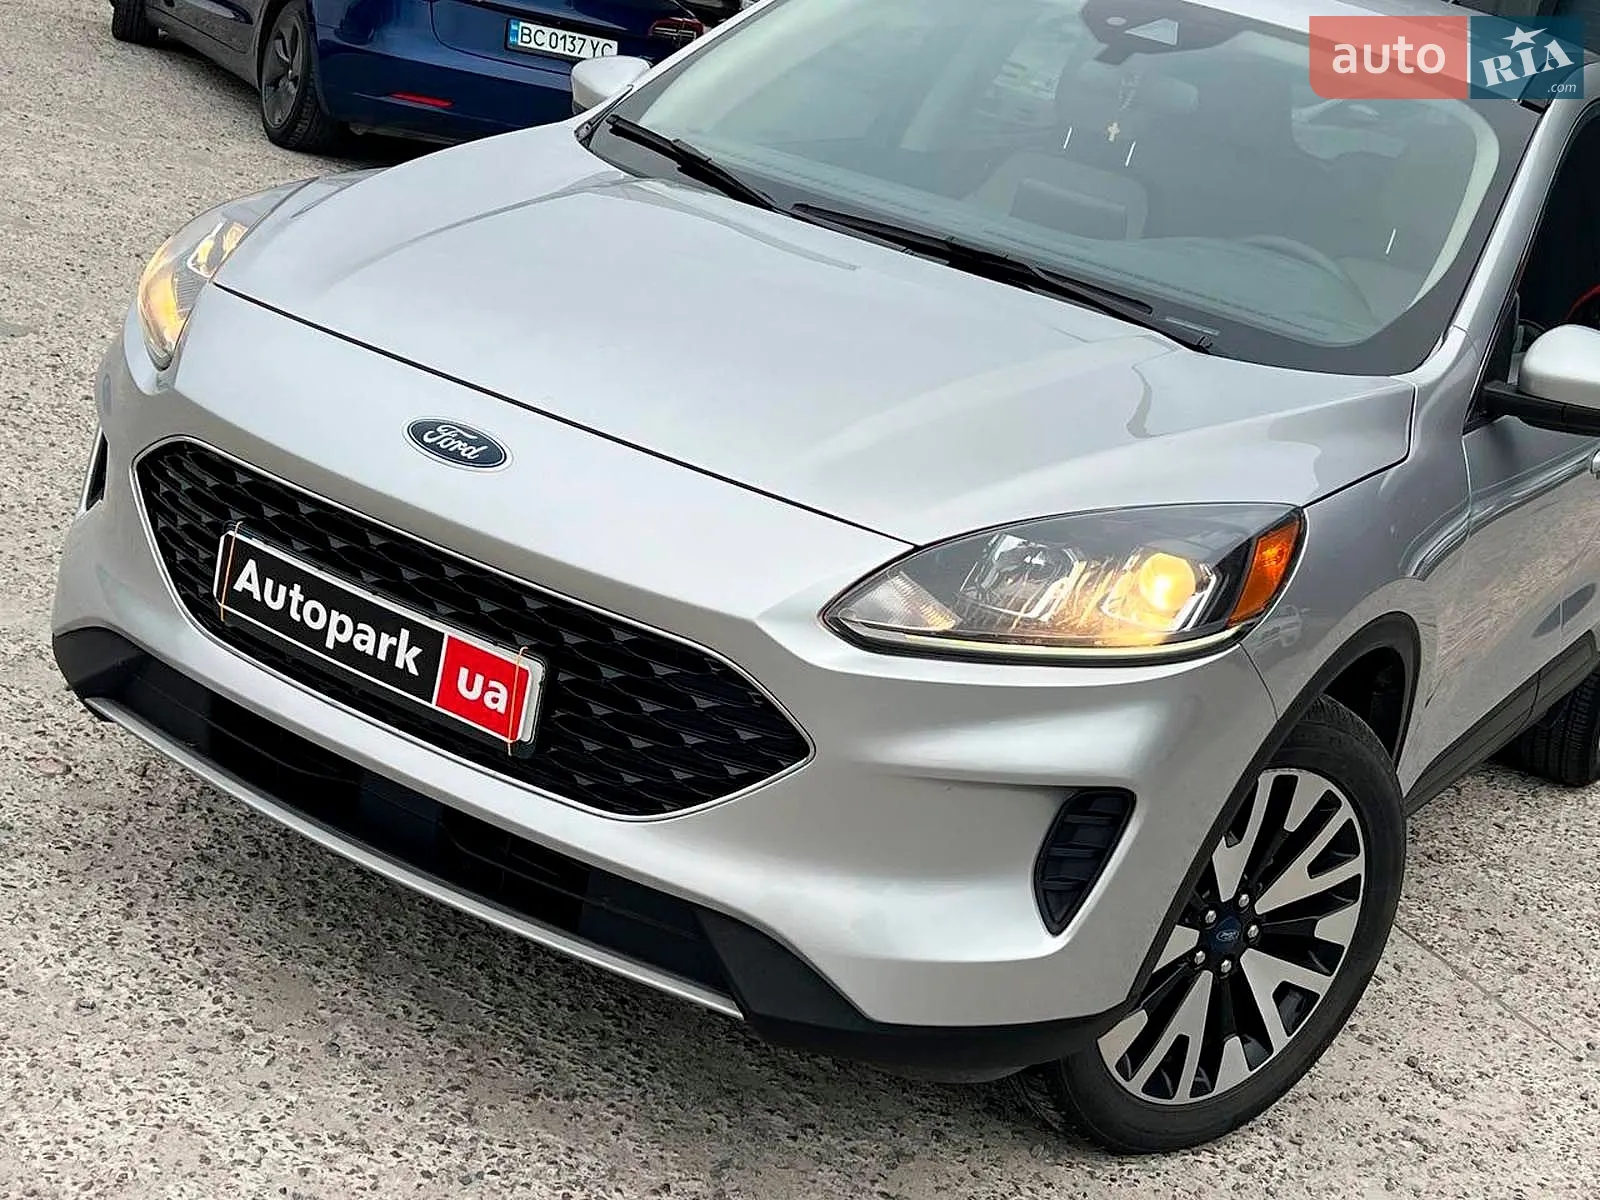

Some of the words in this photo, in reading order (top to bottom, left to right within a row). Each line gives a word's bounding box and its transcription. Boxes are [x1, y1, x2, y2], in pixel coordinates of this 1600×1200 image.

[520, 26, 545, 46] BC
[549, 32, 586, 54] 0137
[423, 424, 488, 459] Ford
[233, 558, 423, 676] Autopark
[457, 666, 509, 715] ua
